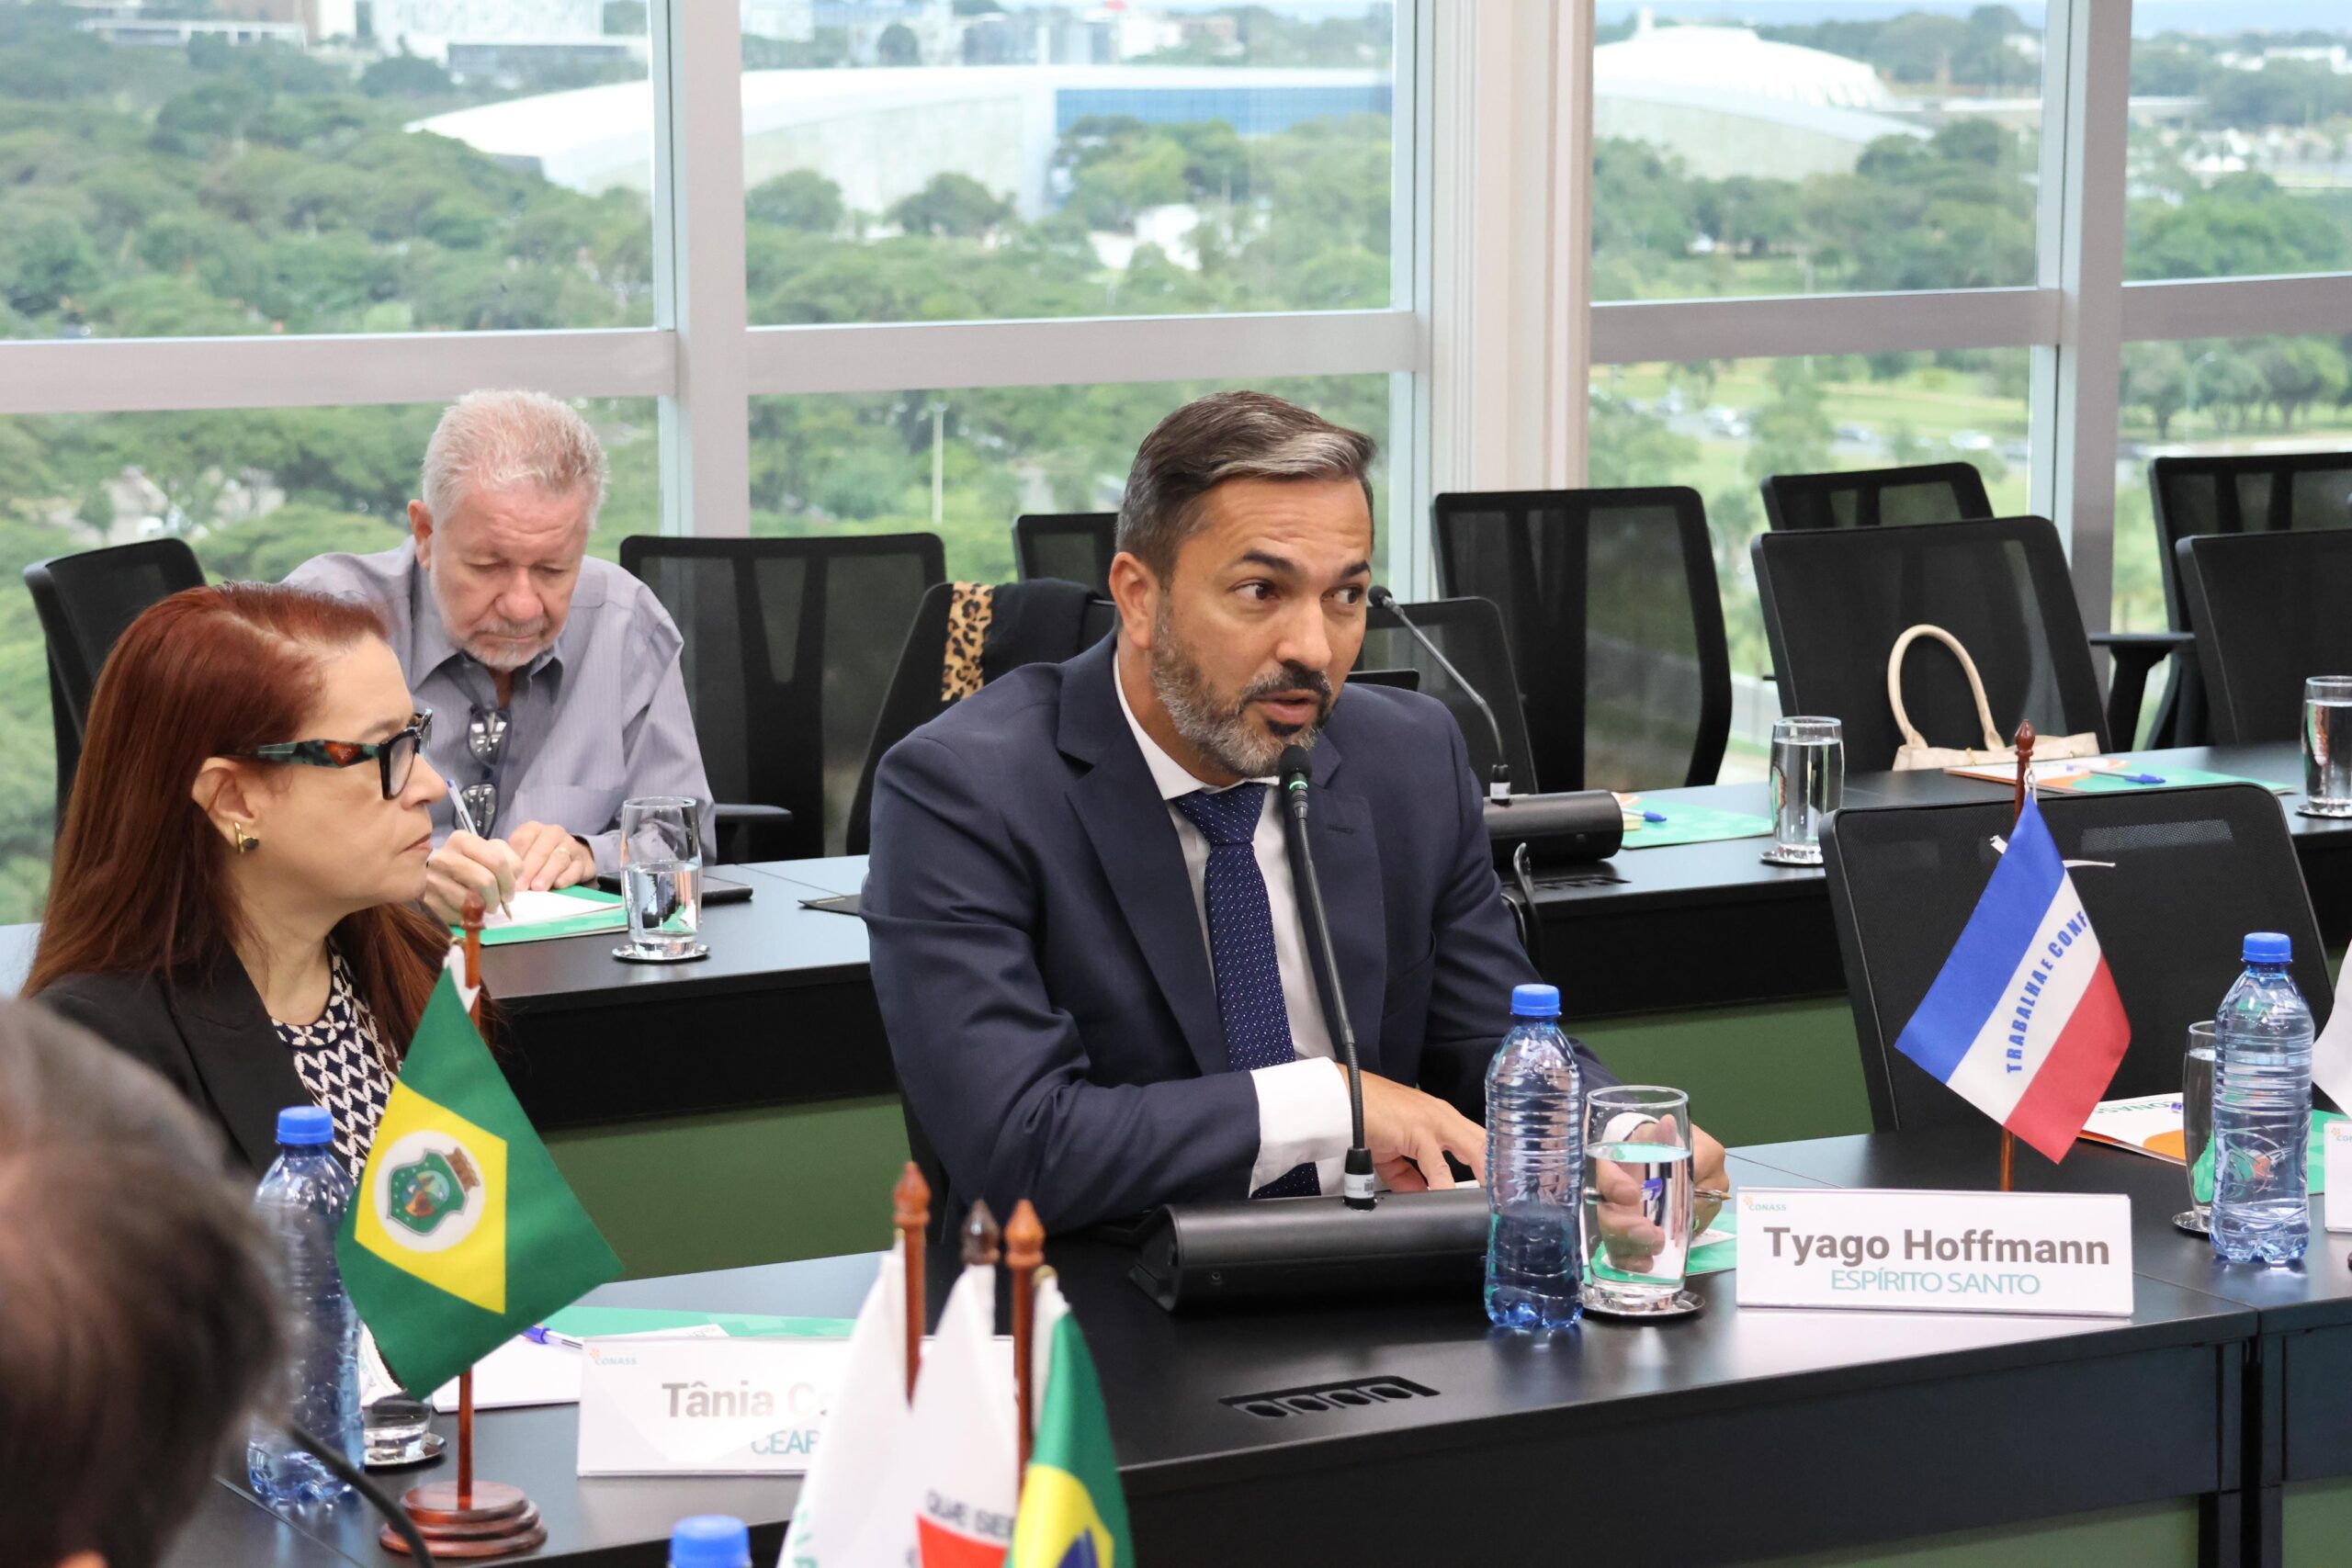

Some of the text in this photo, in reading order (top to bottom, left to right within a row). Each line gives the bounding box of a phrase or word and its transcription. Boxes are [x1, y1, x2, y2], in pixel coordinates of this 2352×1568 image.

[2007, 970, 2048, 1073] TRABALHA
[2040, 958, 2053, 971] E
[1748, 1203, 1787, 1212] CONASS
[1763, 1226, 2110, 1268] Tyago Hoffmann
[1831, 1266, 2041, 1295] ESPÍRITO SANTO
[594, 1356, 638, 1366] CONASS
[662, 1380, 775, 1417] Tânia
